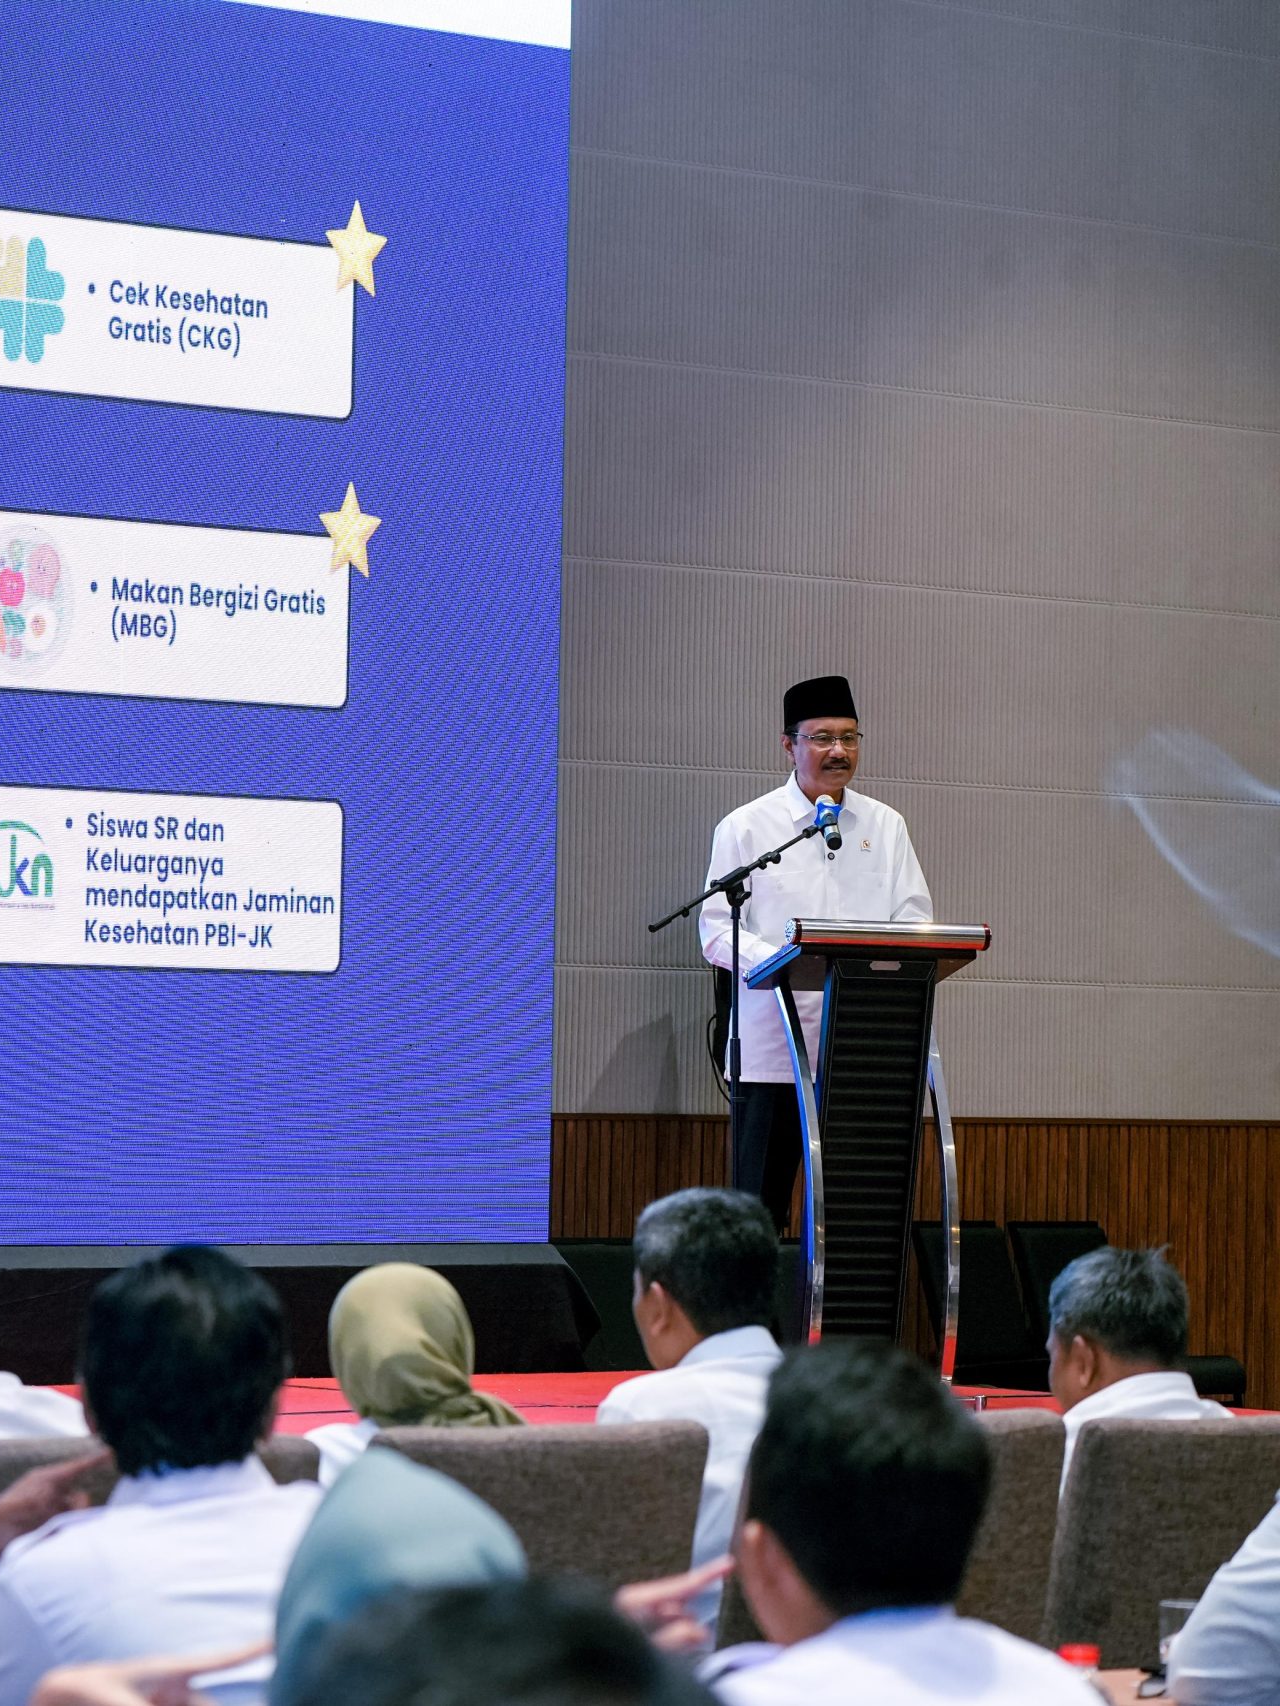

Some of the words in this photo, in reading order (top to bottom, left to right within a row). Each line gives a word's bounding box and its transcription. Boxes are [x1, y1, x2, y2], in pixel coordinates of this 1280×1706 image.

[109, 280, 149, 308] Cek
[155, 284, 269, 320] Kesehatan
[108, 316, 172, 346] Gratis
[178, 317, 241, 358] (CKG)
[111, 577, 184, 606] Makan
[189, 582, 259, 617] Bergizi
[264, 588, 326, 616] Gratis
[111, 605, 177, 646] (MBG)
[86, 812, 148, 839] Siswa
[154, 816, 179, 840] SR
[184, 817, 224, 842] dan
[86, 848, 224, 884] Keluarganya
[85, 884, 238, 917] mendapatkan
[242, 888, 335, 915] Jaminan
[84, 919, 199, 946] Kesehatan
[204, 923, 274, 949] PBI-JK
